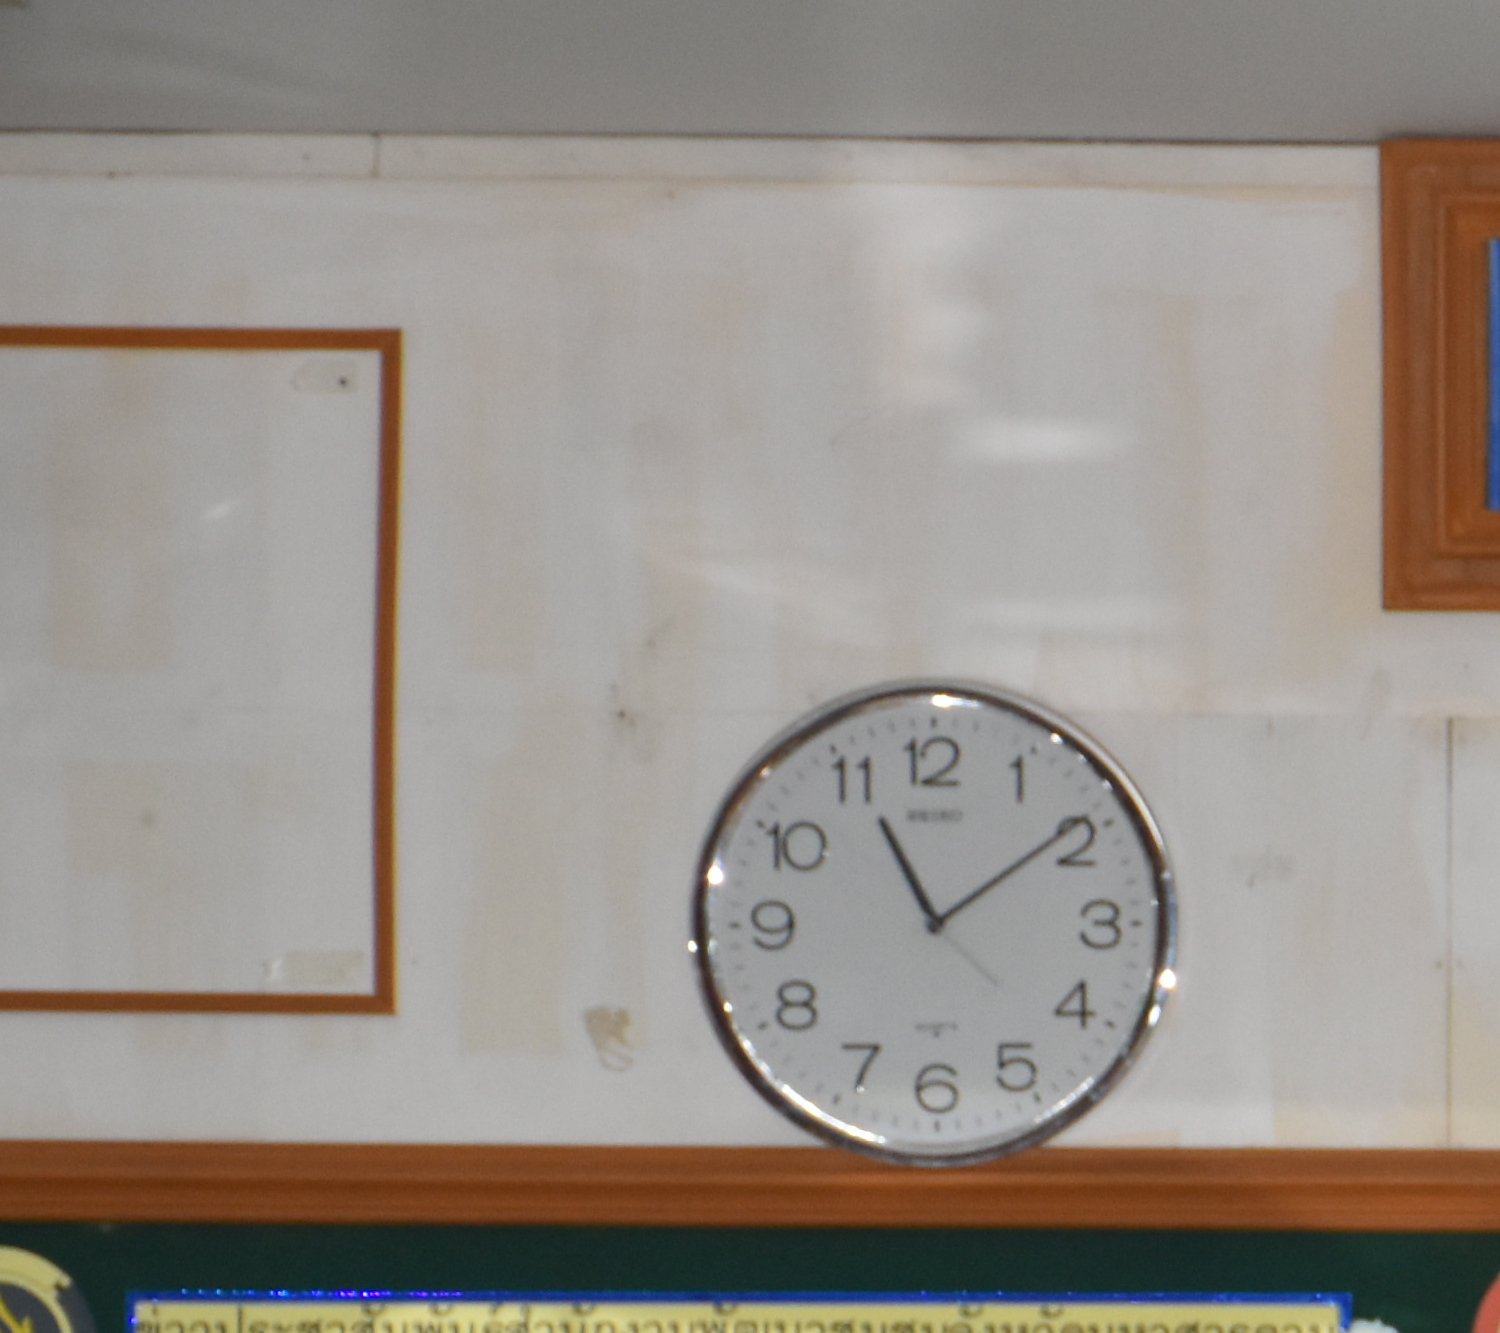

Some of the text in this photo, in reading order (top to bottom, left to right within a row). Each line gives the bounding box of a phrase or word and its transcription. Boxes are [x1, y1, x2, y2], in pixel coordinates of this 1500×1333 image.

[831, 755, 872, 803] 11
[904, 736, 960, 787] 12
[1010, 754, 1025, 803] 1
[768, 821, 827, 871] 10
[1056, 816, 1096, 866] 2
[751, 901, 795, 950] 9
[1080, 901, 1121, 949] 3
[776, 981, 817, 1030] 8
[1054, 980, 1096, 1028] 4
[842, 1043, 882, 1091] 7
[916, 1063, 960, 1113] 6
[997, 1043, 1037, 1092] 5
